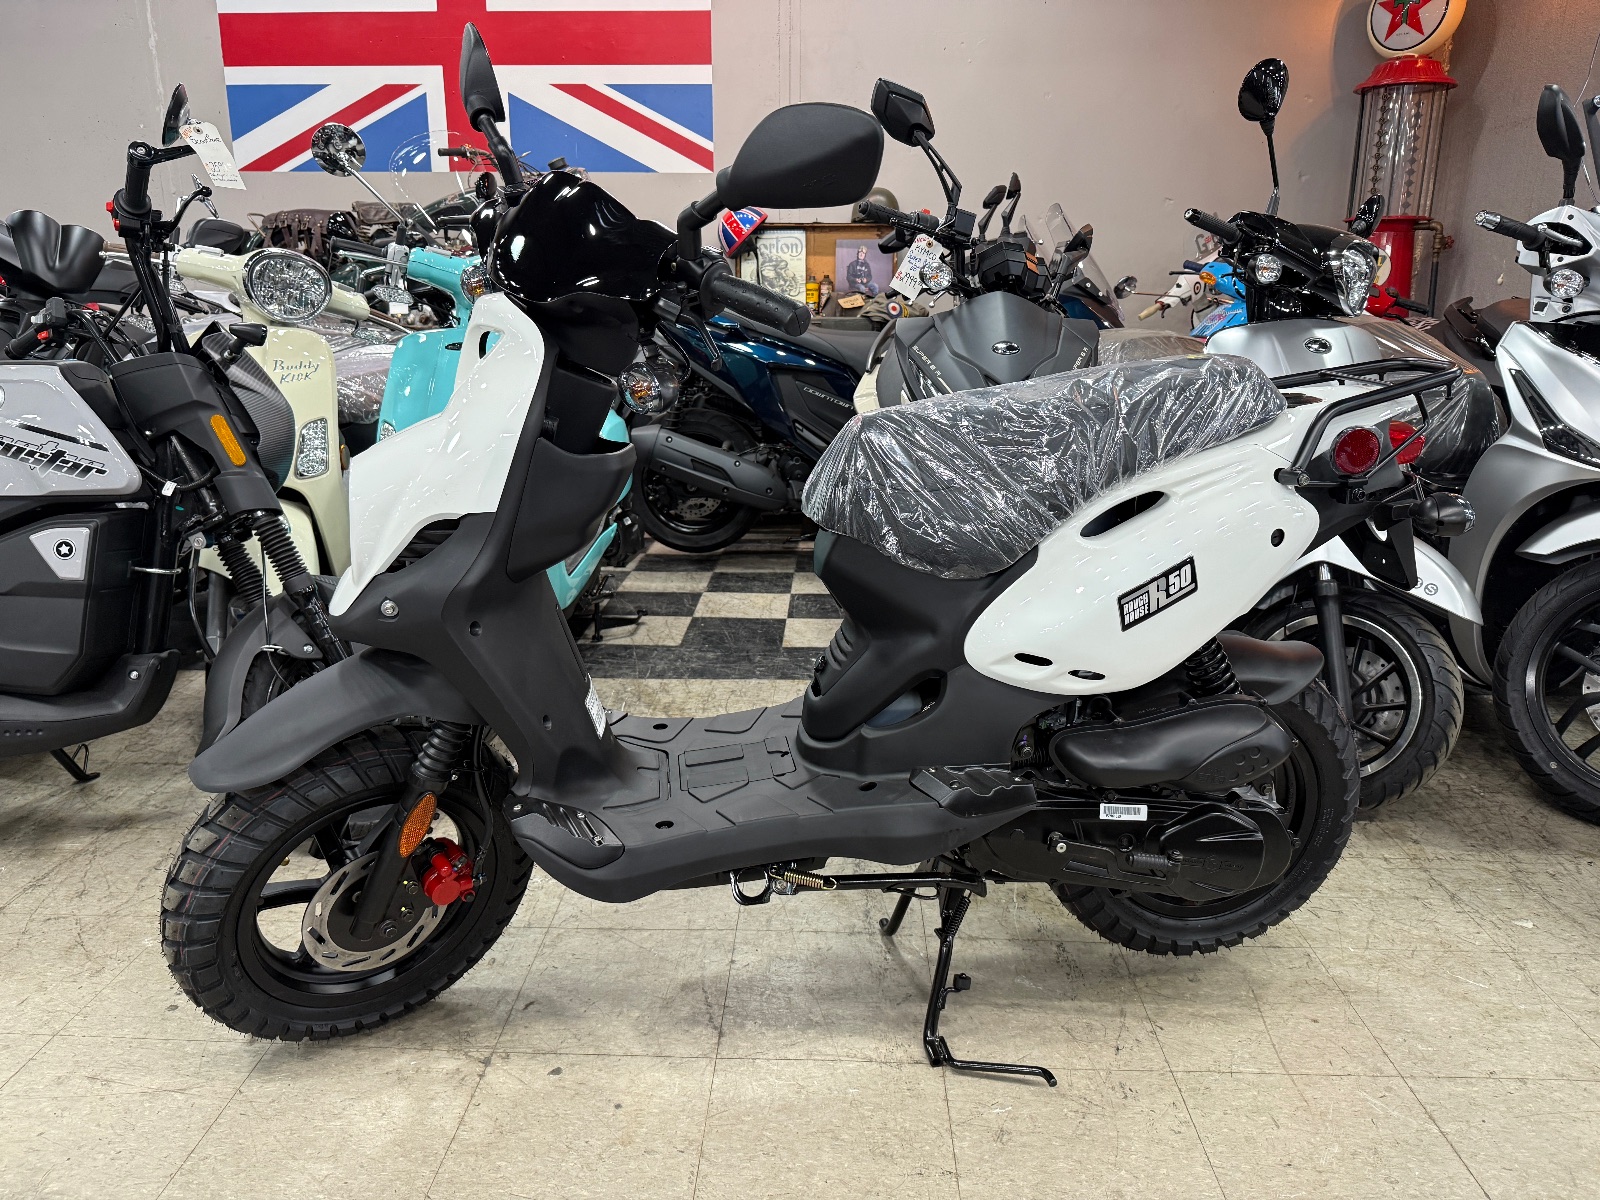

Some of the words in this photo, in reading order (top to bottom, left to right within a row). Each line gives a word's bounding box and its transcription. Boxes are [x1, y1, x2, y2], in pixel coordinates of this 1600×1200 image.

[757, 234, 803, 258] orton
[272, 359, 320, 373] Buddy
[1123, 592, 1149, 615] ROUGH
[1124, 603, 1149, 626] HOUSE
